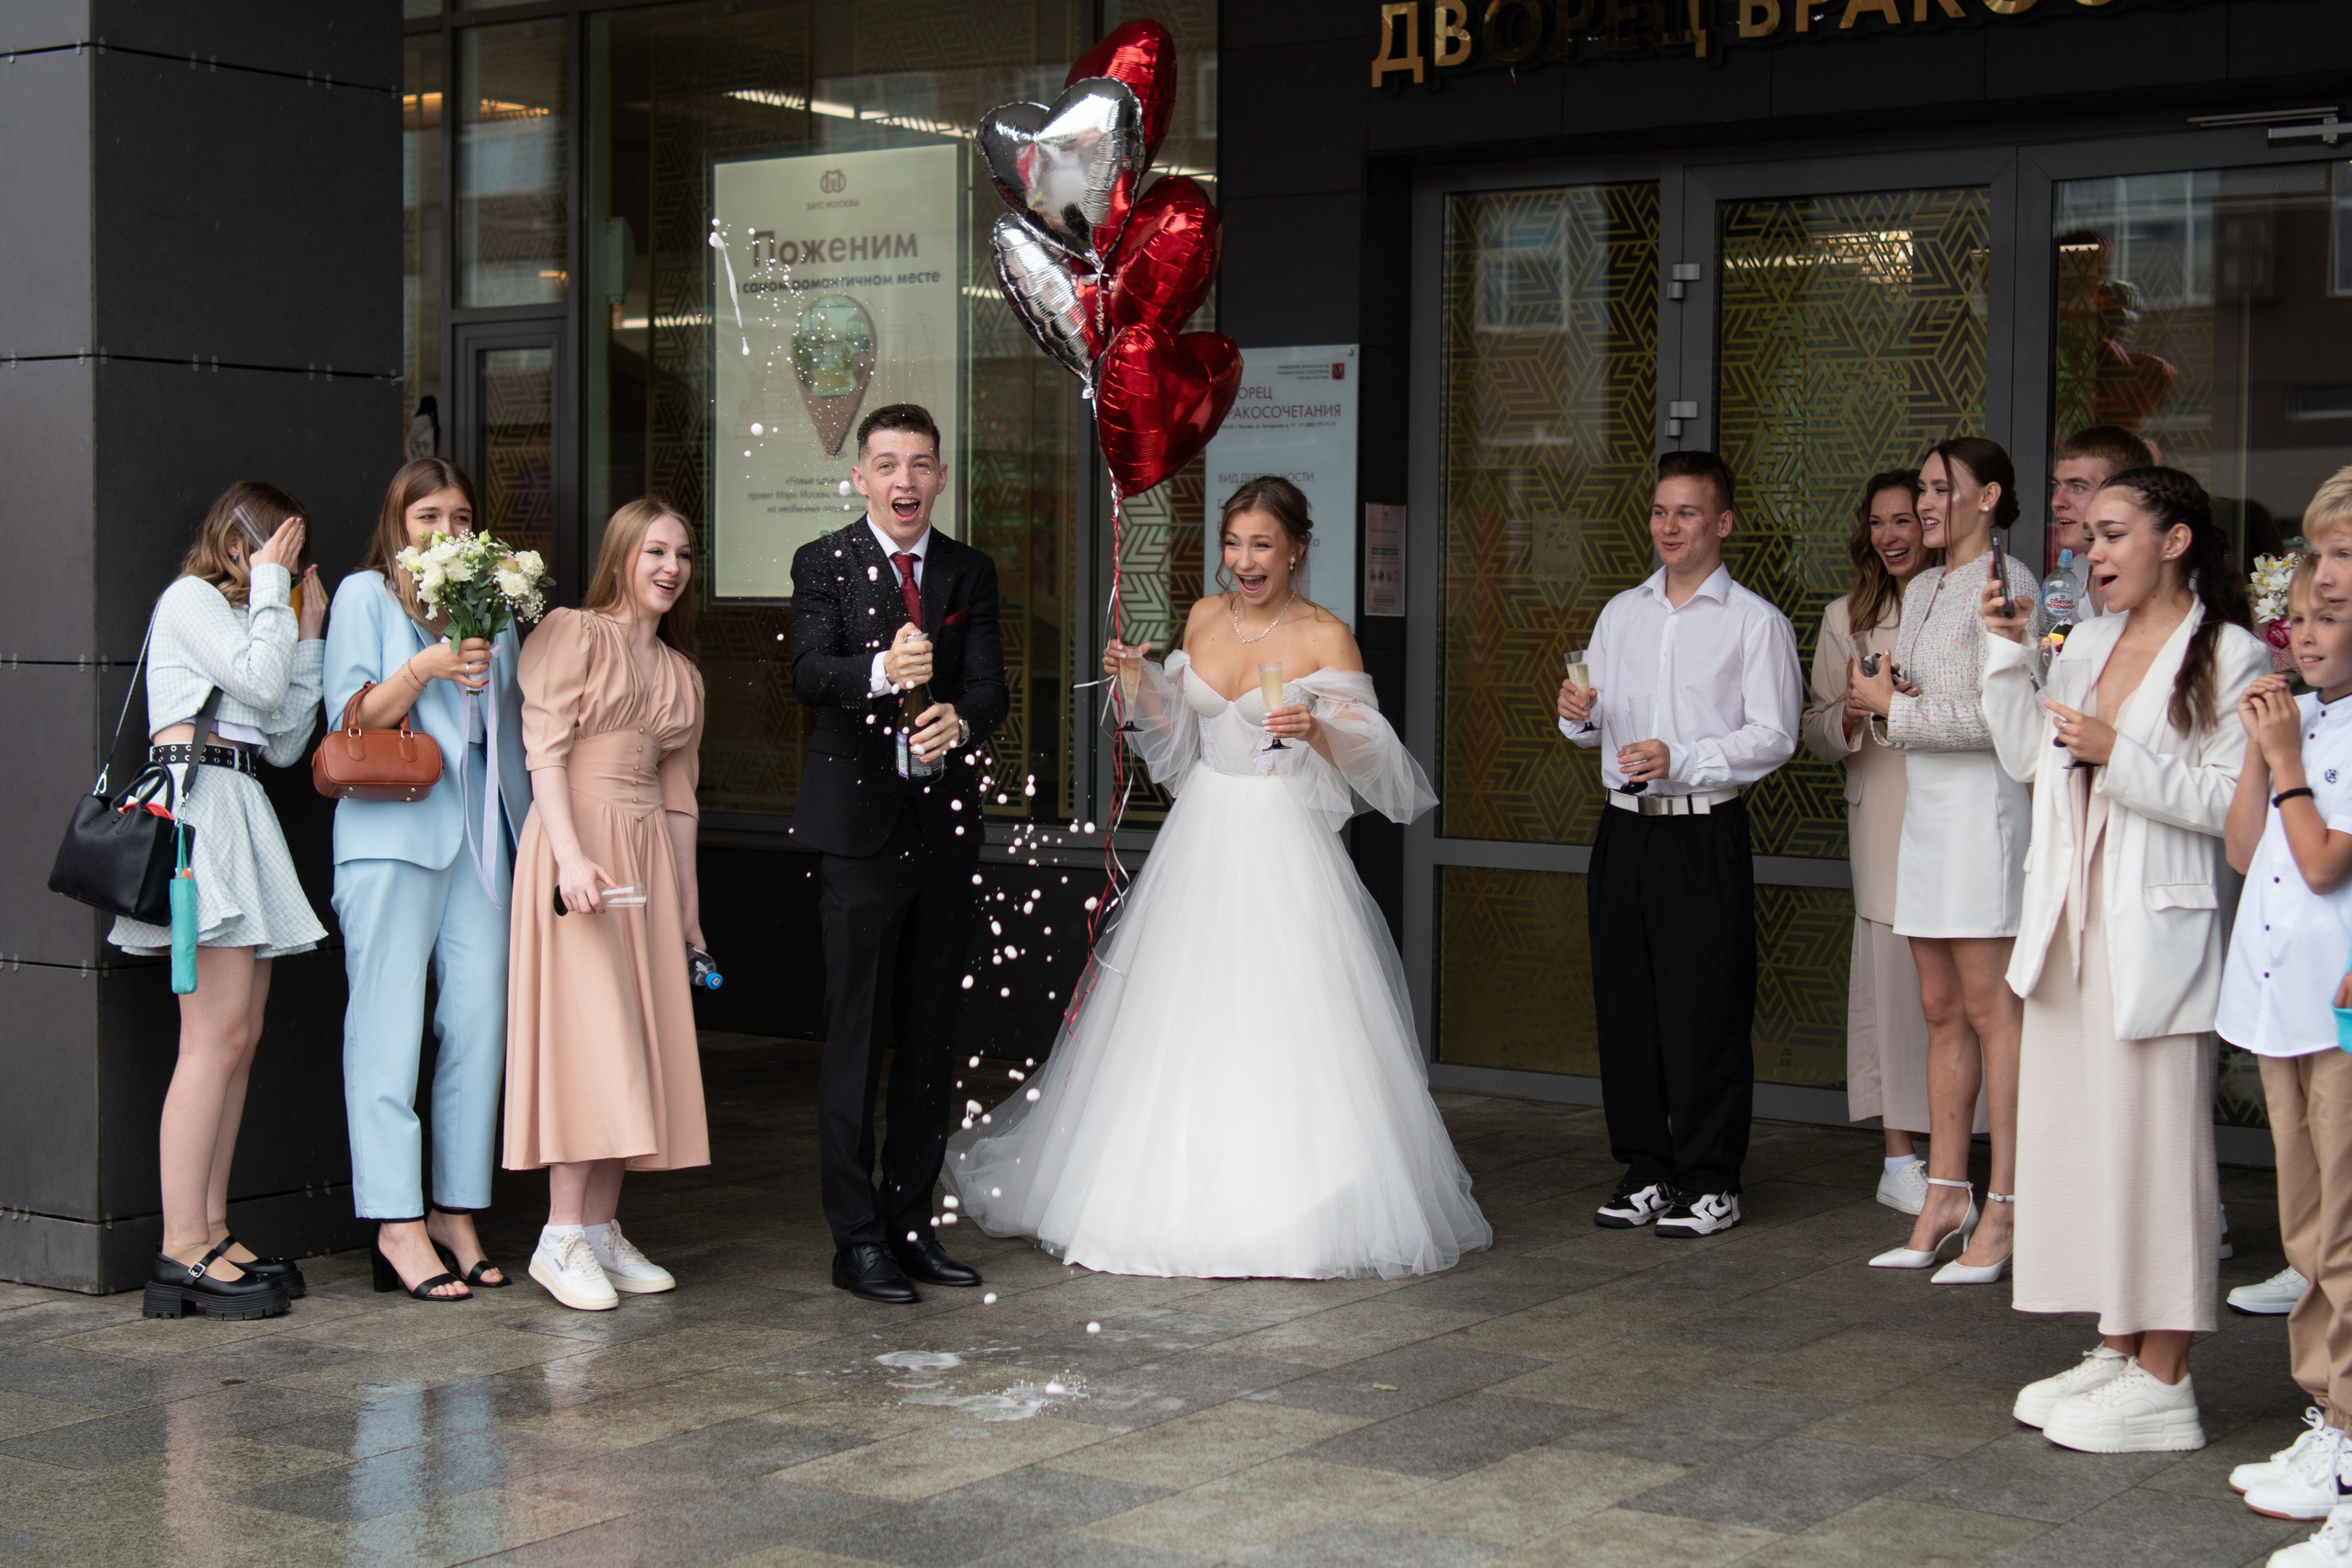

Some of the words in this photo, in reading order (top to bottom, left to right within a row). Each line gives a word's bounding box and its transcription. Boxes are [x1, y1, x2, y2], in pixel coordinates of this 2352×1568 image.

[1371, 0, 1708, 88] ДВОРЕЦ
[753, 230, 919, 267] Поженим
[742, 281, 788, 294] самом
[792, 275, 893, 293] романтичном
[897, 271, 941, 285] месте
[1237, 386, 1273, 400] ОРЕЦ
[1227, 404, 1341, 420] РАКОСОЧЕТАНИЯ
[1218, 473, 1238, 484] ВИД
